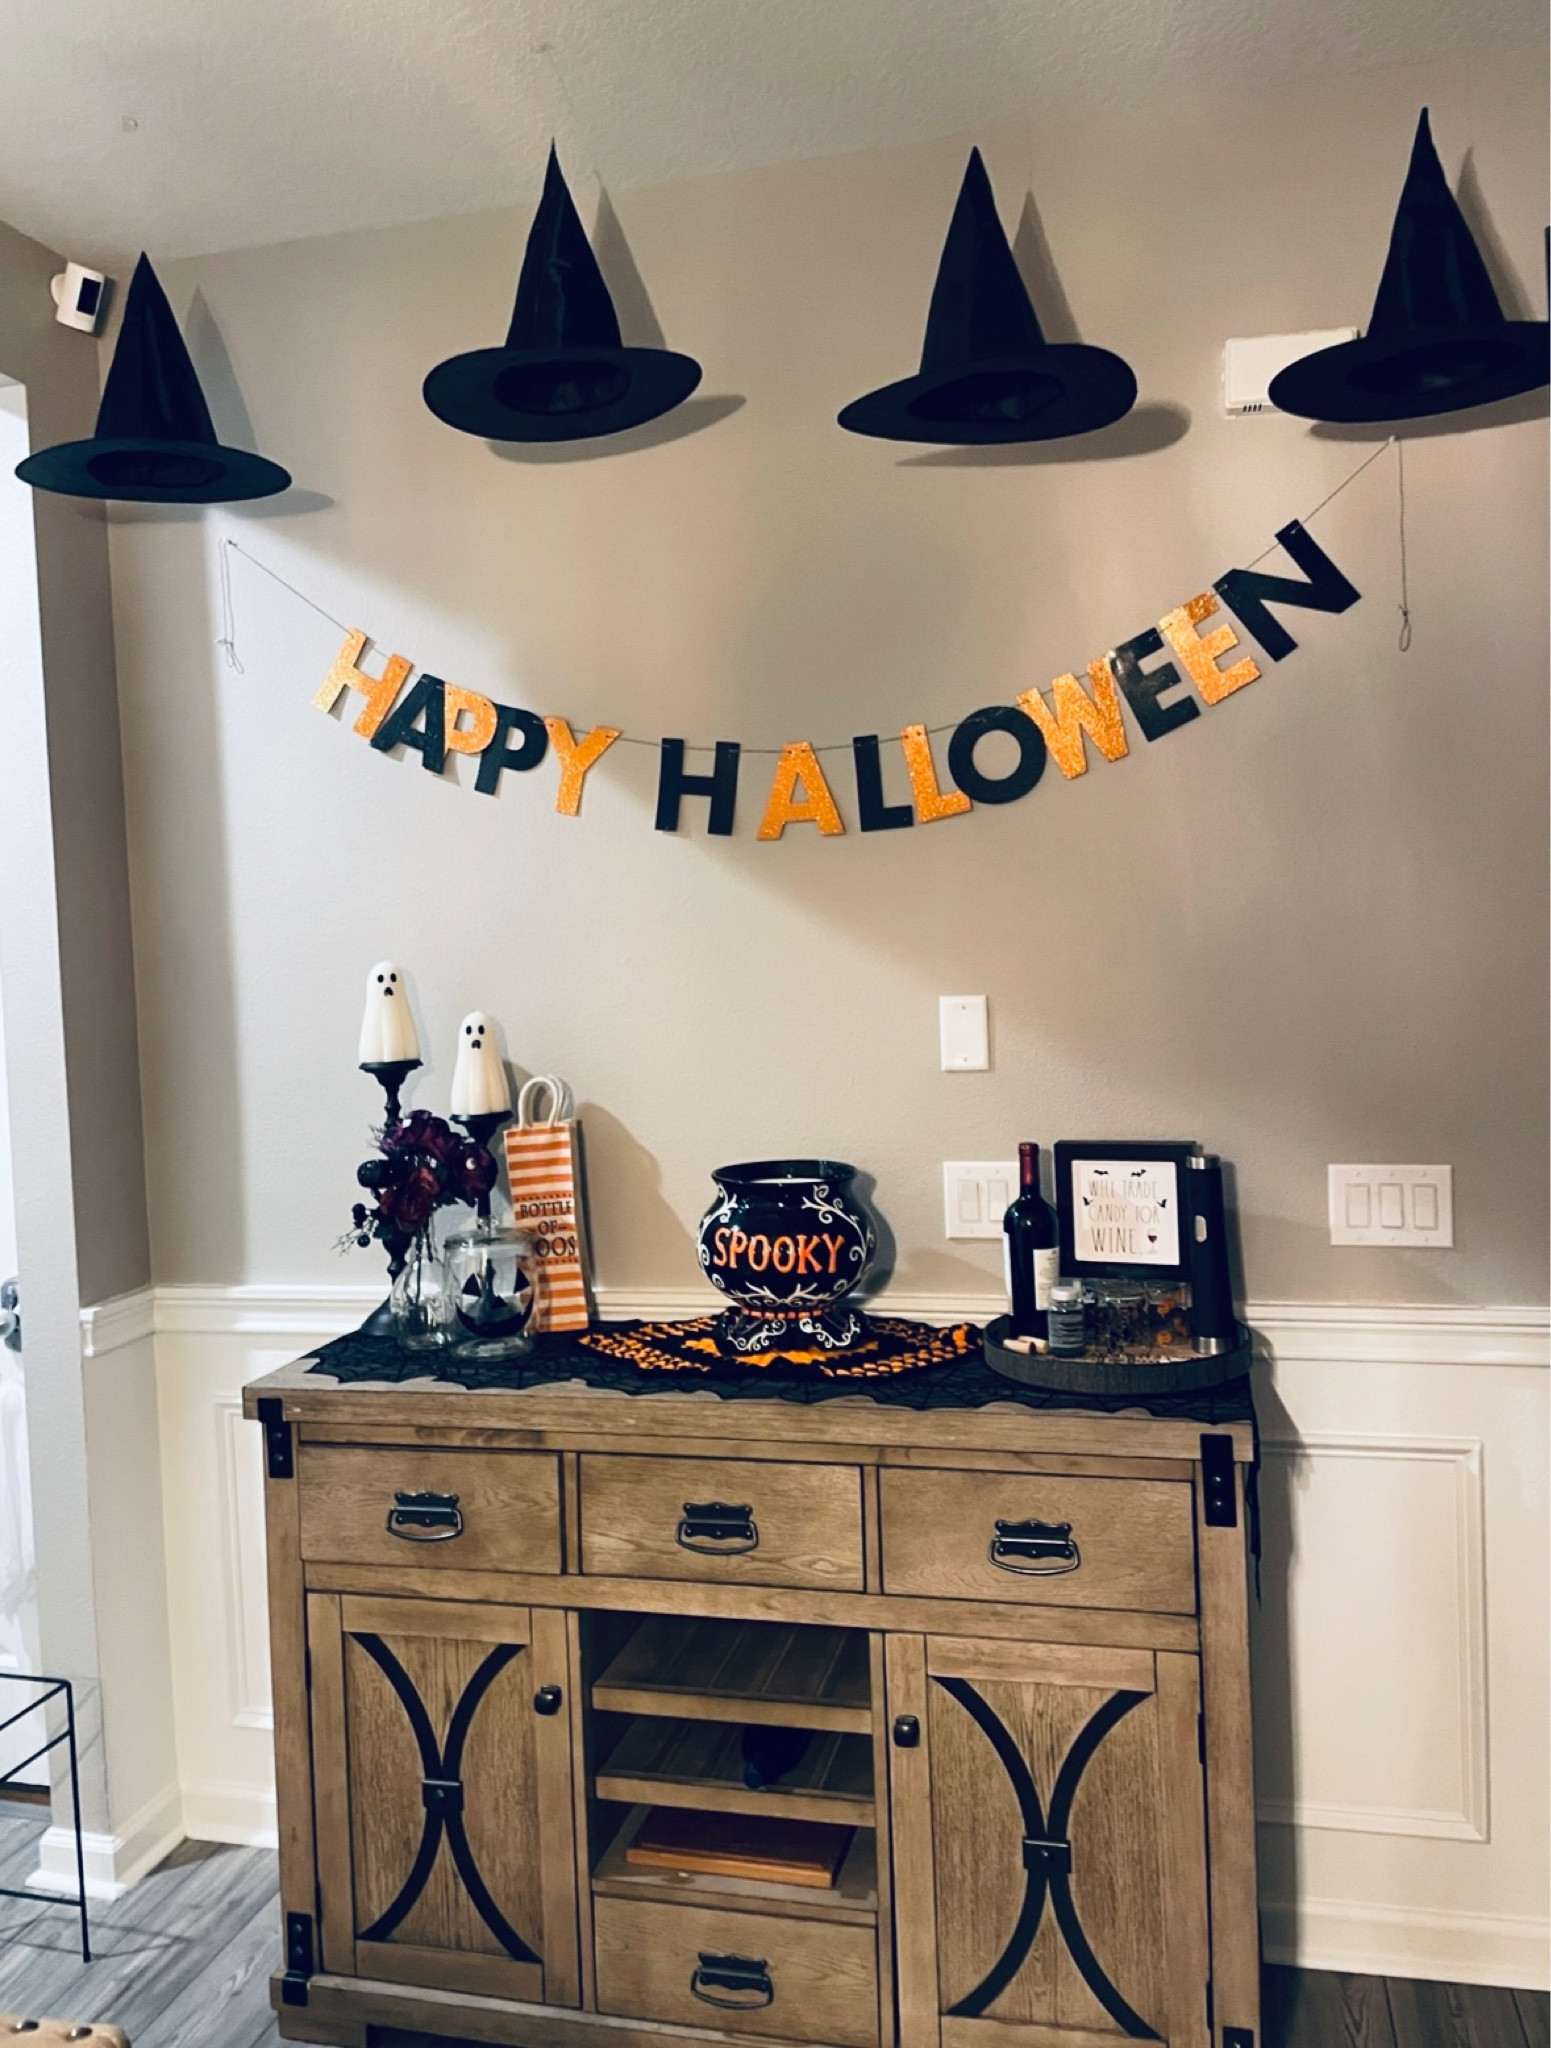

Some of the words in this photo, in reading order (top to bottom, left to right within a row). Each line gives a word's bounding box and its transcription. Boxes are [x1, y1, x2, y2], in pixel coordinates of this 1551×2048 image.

[311, 628, 621, 816] HAPPY
[654, 518, 1362, 842] HALLOWEEN
[1088, 1179, 1115, 1198] WILL
[1122, 1180, 1157, 1199] TRADE
[520, 1201, 572, 1218] BOTTLE
[1088, 1203, 1127, 1222] CANDY
[533, 1236, 577, 1258] OOS
[713, 1227, 845, 1274] SPOOKY
